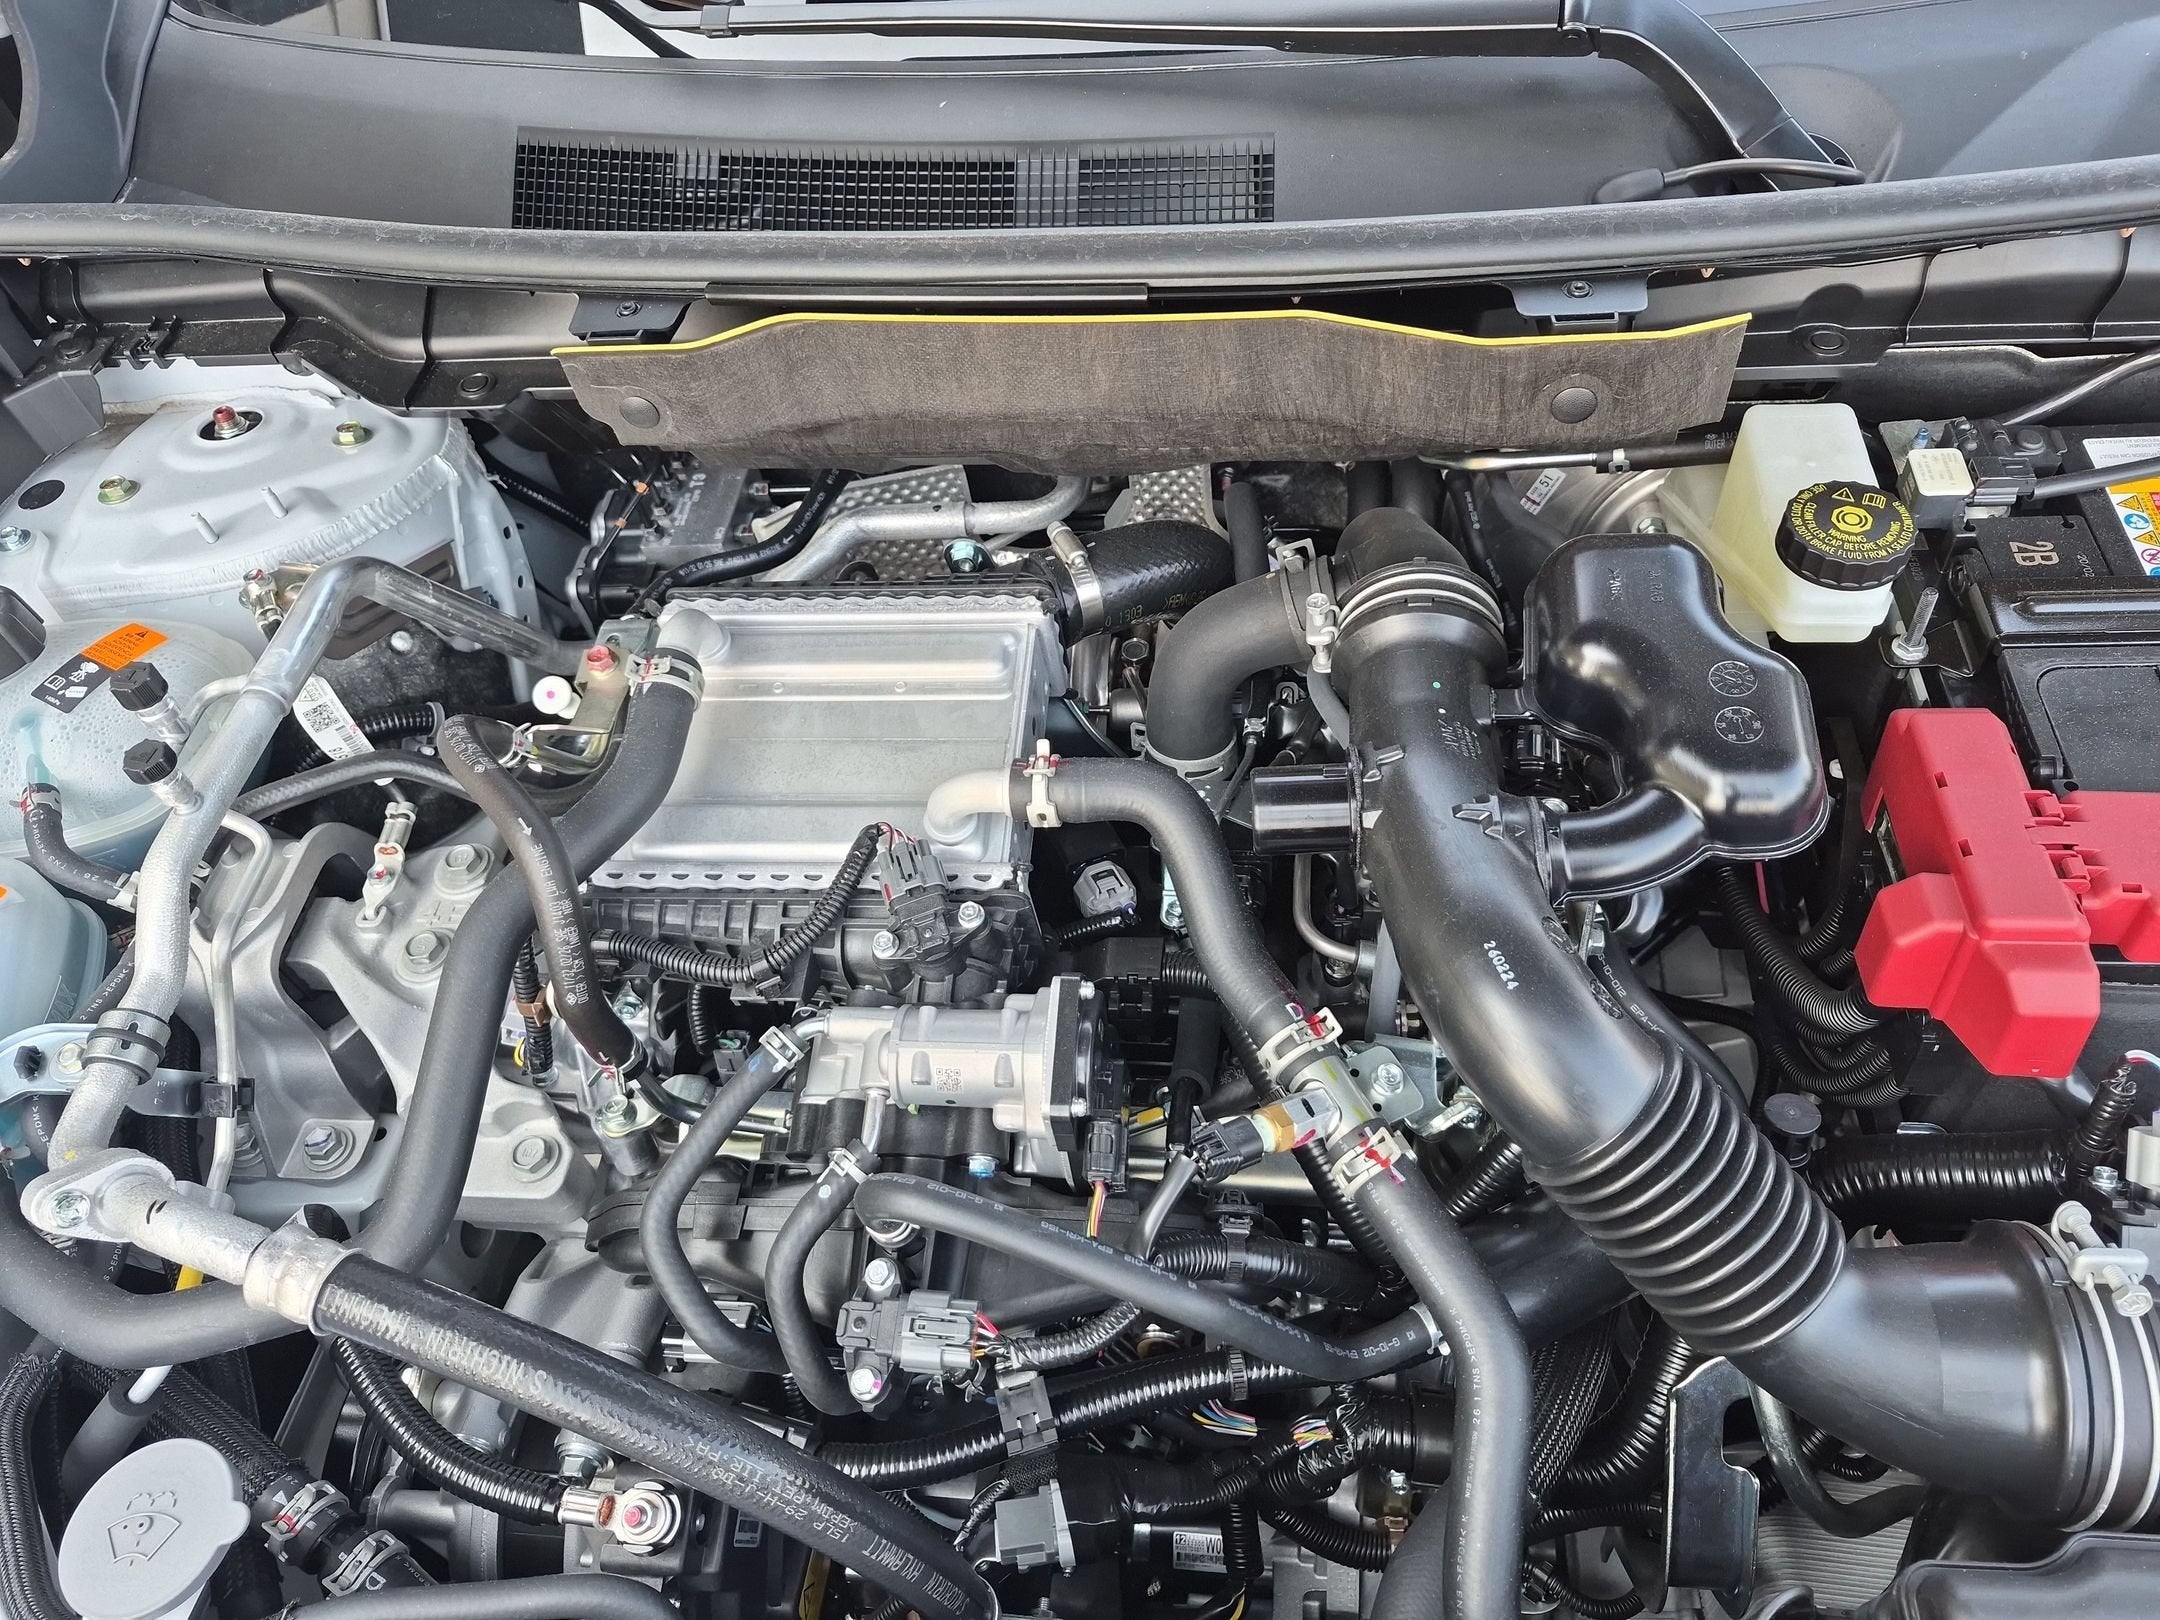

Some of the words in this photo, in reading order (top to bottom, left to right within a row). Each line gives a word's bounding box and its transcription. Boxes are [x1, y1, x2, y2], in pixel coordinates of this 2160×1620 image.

[1810, 484, 1827, 494] USE
[1803, 502, 1817, 520] CLEAN
[1805, 520, 1826, 540] FILLER
[1828, 528, 1867, 542] WARNING
[1876, 521, 1901, 548] REMOVING
[1809, 538, 1836, 555] BRAKE
[1824, 537, 1842, 547] CAP
[1843, 542, 1878, 551] BEFORE
[1886, 547, 1894, 555] A
[1891, 531, 1913, 551] SEALED
[1837, 549, 1862, 560] FLUID
[1864, 549, 1888, 560] FROM
[2009, 540, 2060, 568] 2B
[530, 843, 553, 878] ENGINE
[567, 925, 581, 948] INNER
[1483, 940, 1520, 991] 260224
[575, 980, 589, 1005] OUTER
[926, 1182, 984, 1204] G-10-012
[1366, 1181, 1382, 1206] TNS
[1454, 1317, 1480, 1366] >EPDM<
[1471, 1366, 1481, 1390] TNS
[1471, 1407, 1481, 1426] 26
[1174, 1533, 1187, 1545] 12
[861, 1534, 926, 1583] HYLAMMIT
[1455, 1526, 1469, 1587] >EPDM<
